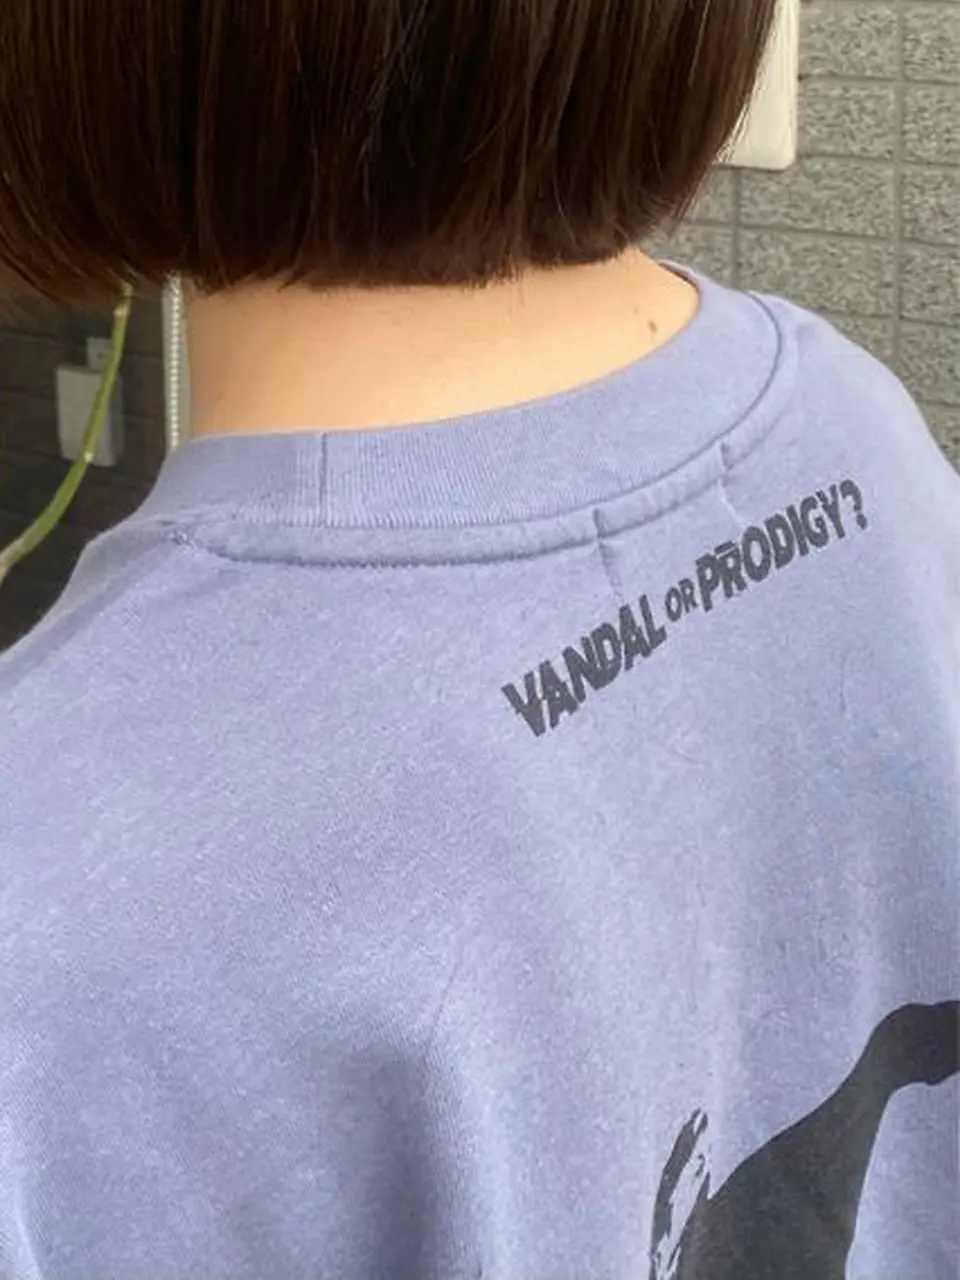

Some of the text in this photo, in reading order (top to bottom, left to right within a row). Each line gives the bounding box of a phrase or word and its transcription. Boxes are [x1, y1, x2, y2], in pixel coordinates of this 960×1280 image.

[500, 478, 869, 738] VANDAL OR PRODIGY?
